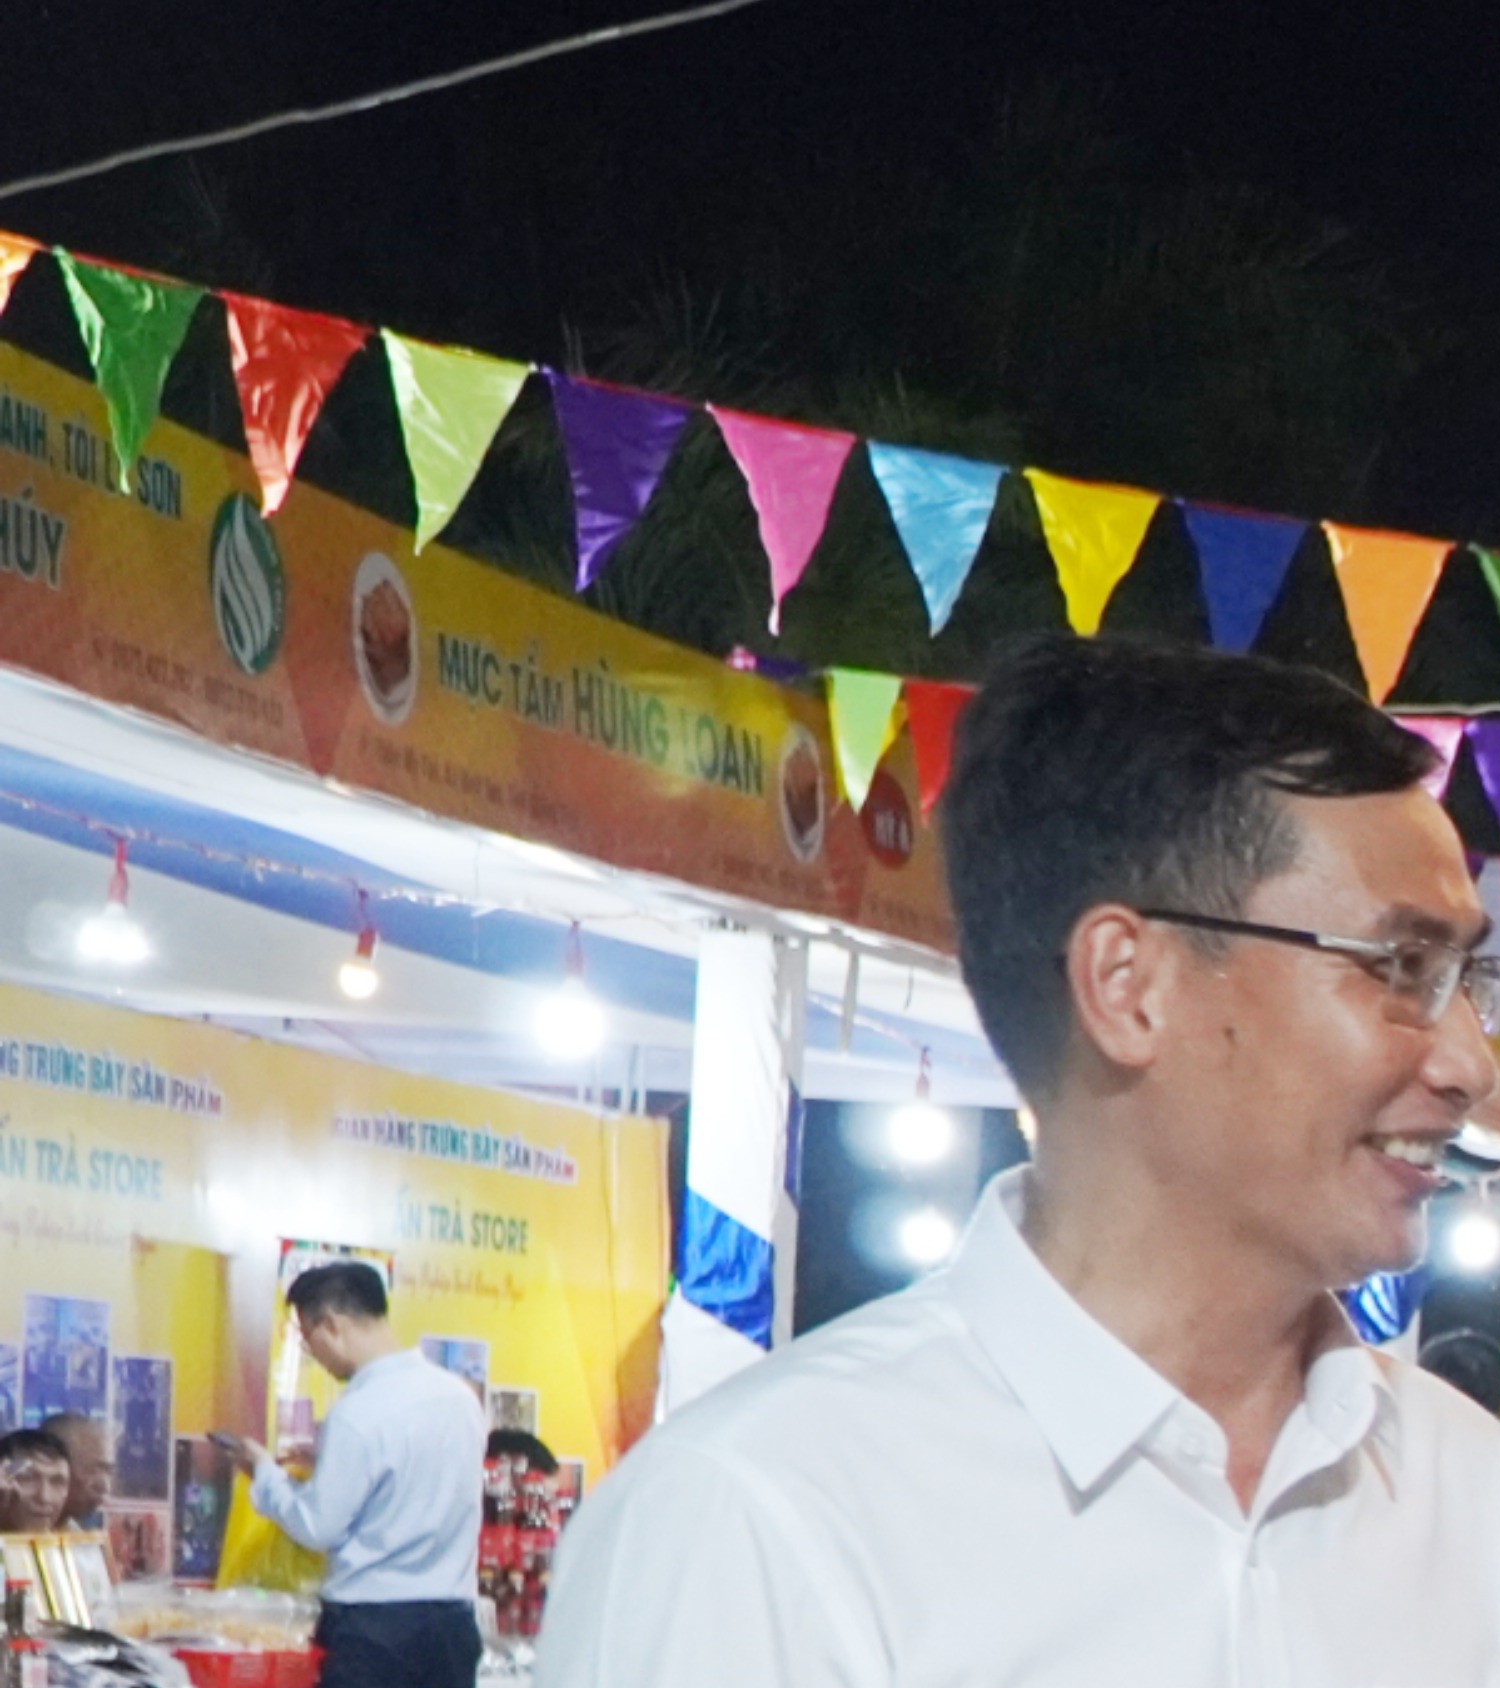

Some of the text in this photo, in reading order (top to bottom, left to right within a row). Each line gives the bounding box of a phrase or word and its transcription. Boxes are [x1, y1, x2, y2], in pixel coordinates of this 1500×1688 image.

[573, 657, 669, 766] HÙNG
[89, 1146, 162, 1202] STORE
[470, 1211, 528, 1256] STORE
